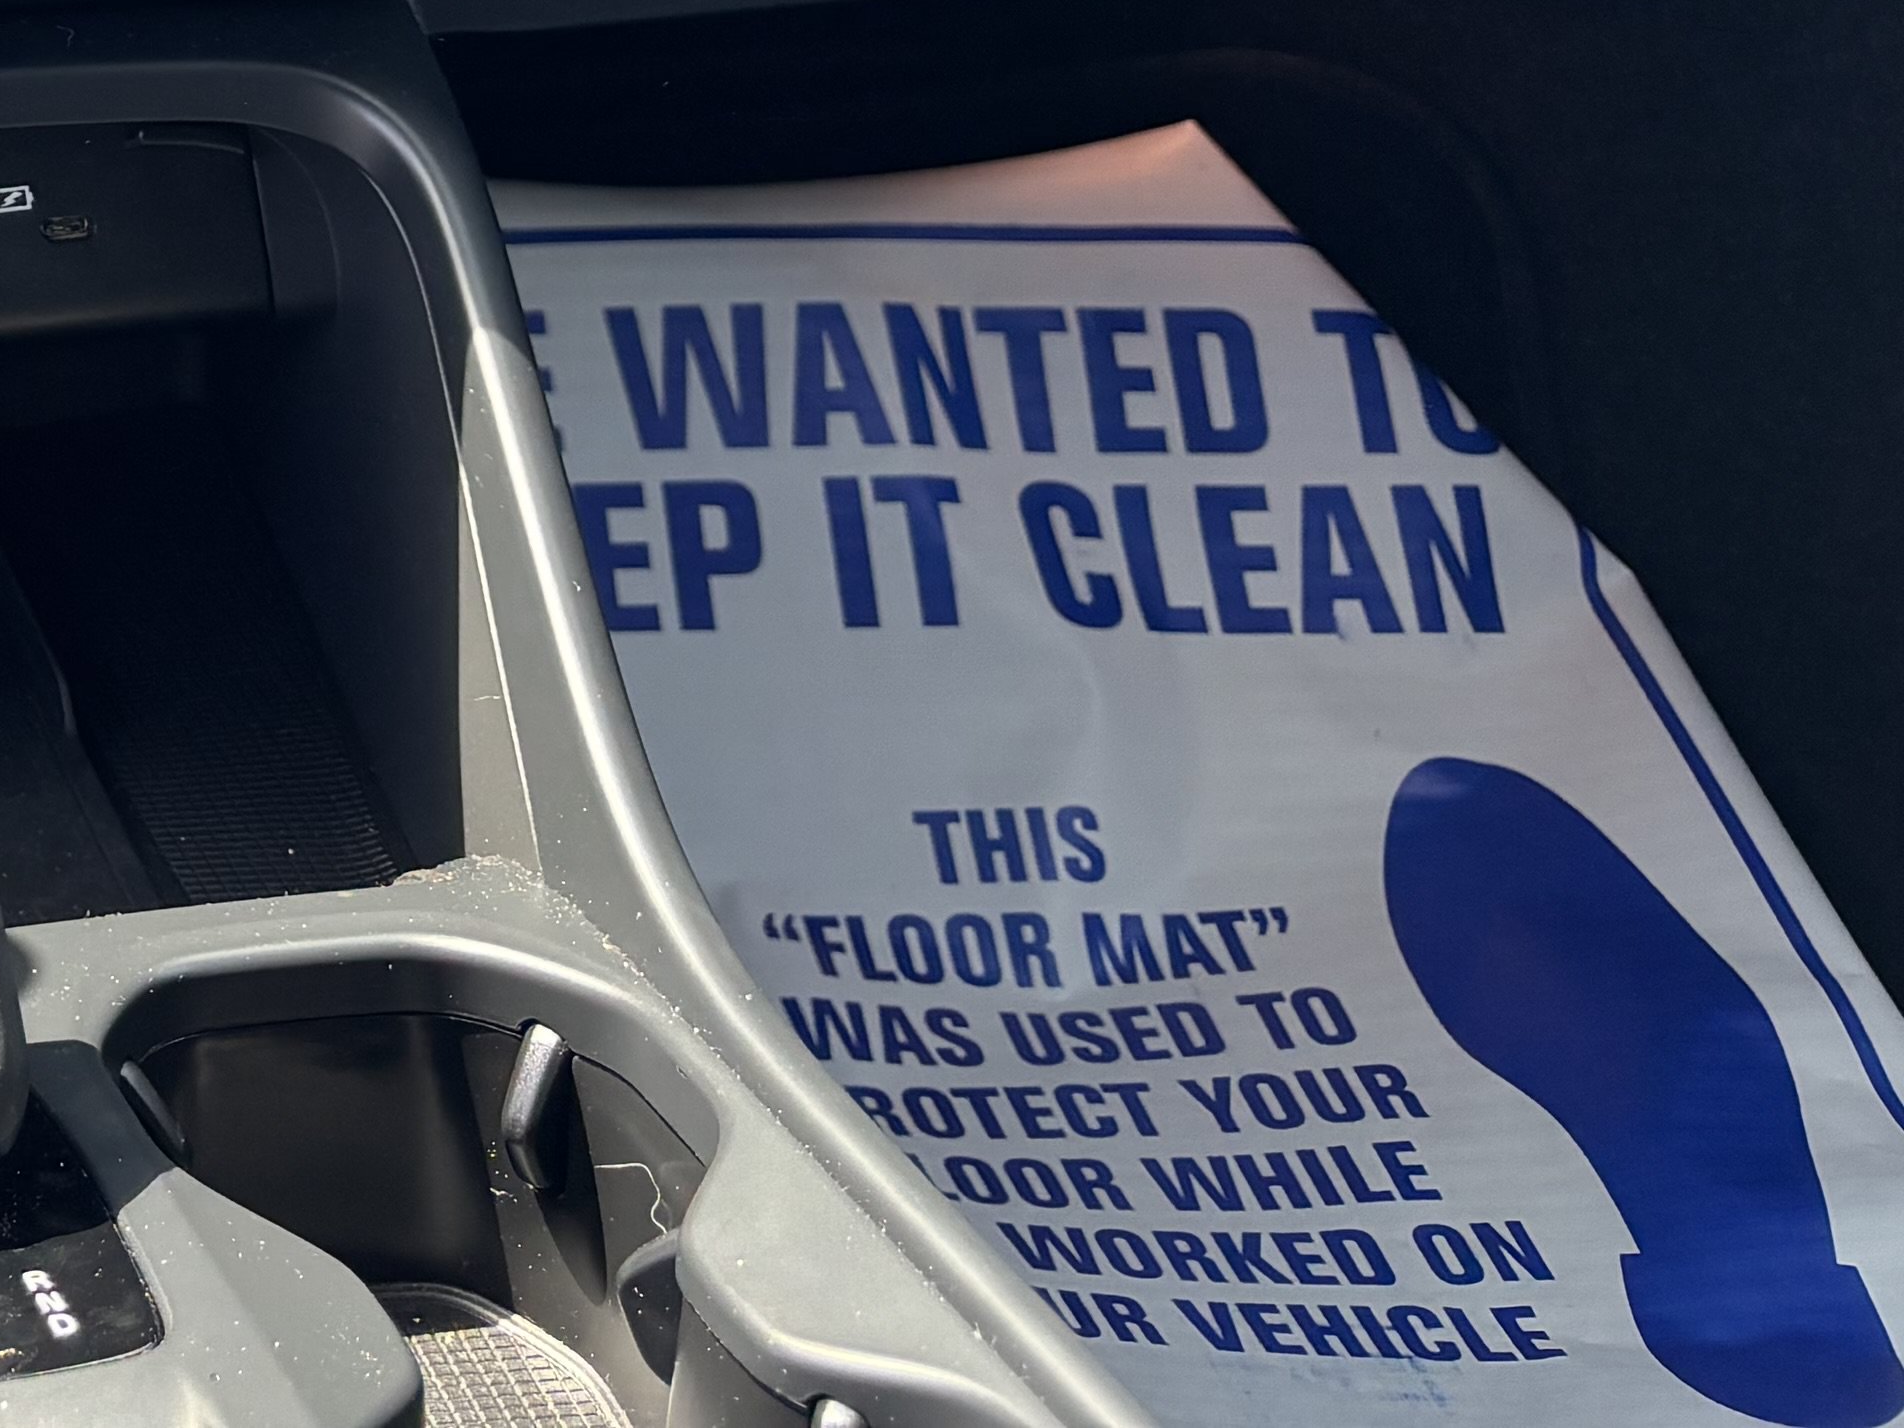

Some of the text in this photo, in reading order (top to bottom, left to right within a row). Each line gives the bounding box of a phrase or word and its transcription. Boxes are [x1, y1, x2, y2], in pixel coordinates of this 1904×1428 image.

[605, 302, 1269, 456] WANTED
[572, 475, 1507, 634] EP IT CLEAN
[913, 805, 1106, 885] THIS
[780, 987, 1356, 1067] WAS USED TO
[844, 1063, 1429, 1140] ROTECT YOUR
[905, 1140, 1443, 1213] LOOR WHILE
[21, 1269, 56, 1294] R
[996, 1219, 1554, 1287] WORKED ON
[34, 1290, 68, 1315] N
[46, 1313, 82, 1340] D
[1031, 1285, 1569, 1364] UR VEHICLE
